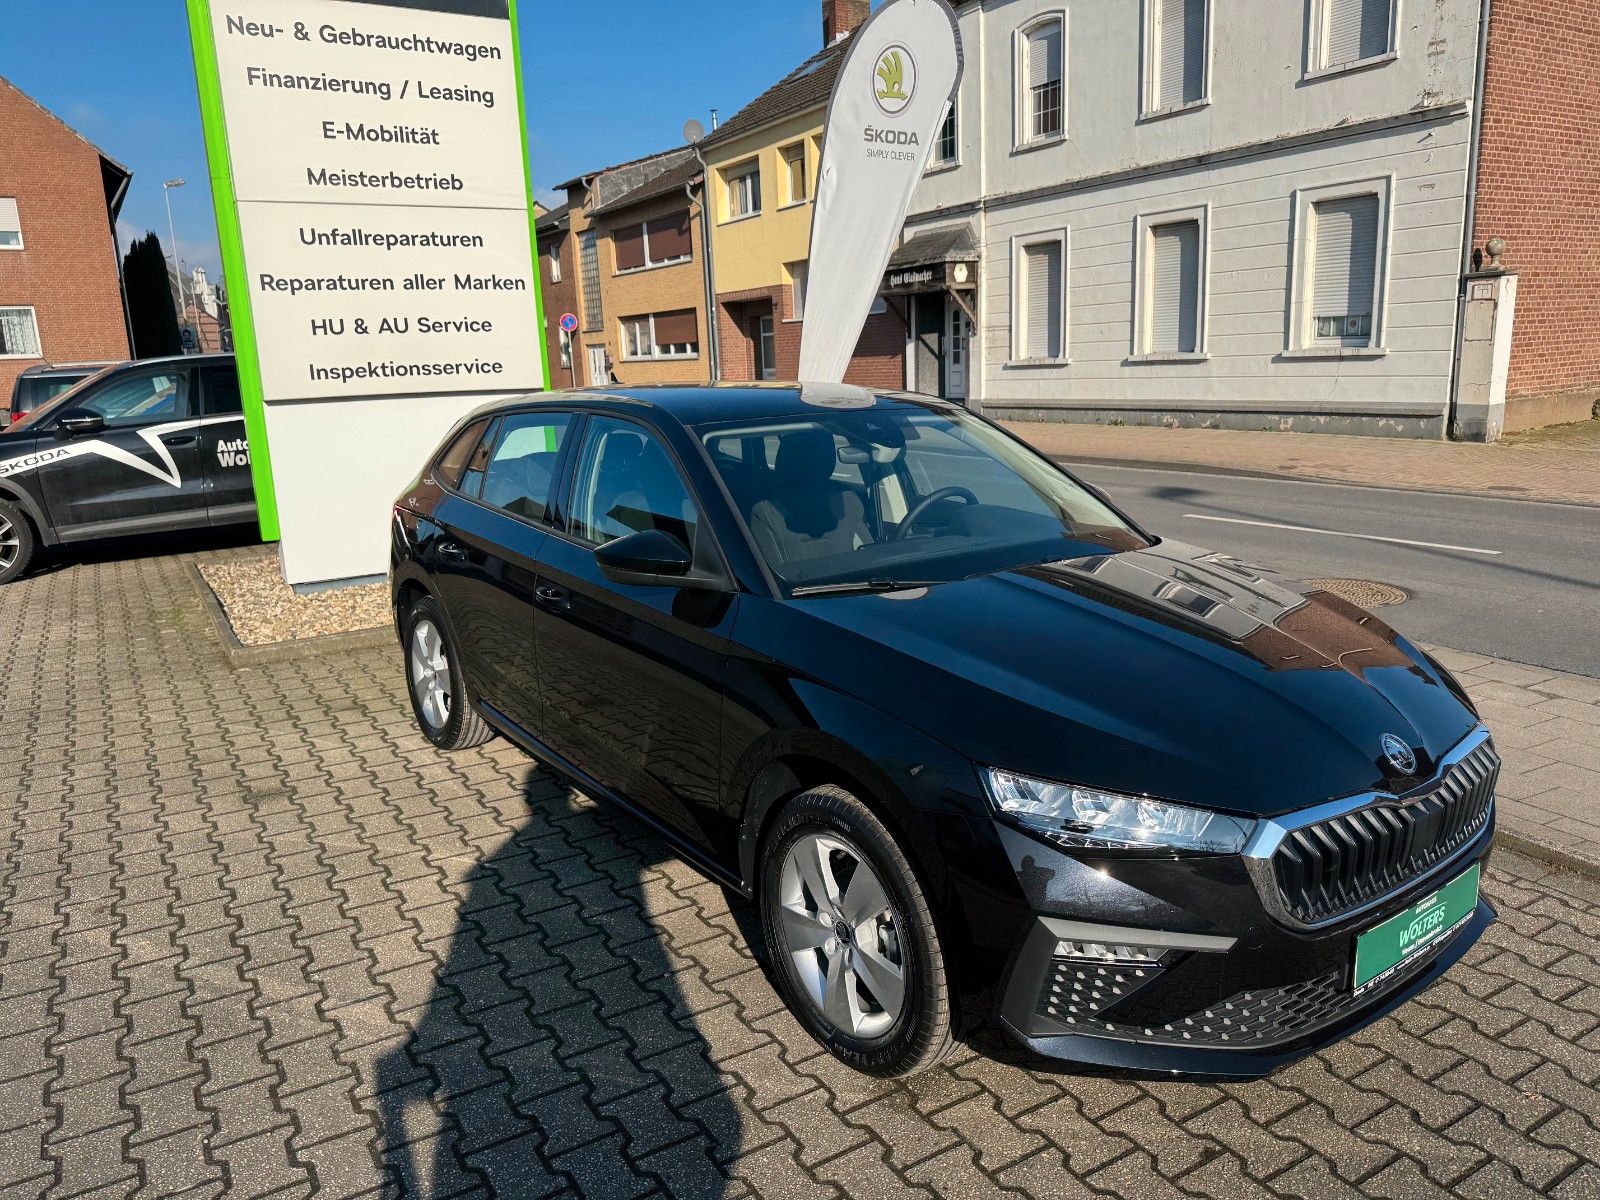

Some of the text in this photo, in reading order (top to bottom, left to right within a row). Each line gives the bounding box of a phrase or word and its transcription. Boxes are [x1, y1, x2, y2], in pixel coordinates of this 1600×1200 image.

[225, 14, 502, 62] Neu- & Gebrauchtwagen
[246, 66, 495, 109] Finanzierung / Leasing
[321, 120, 440, 146] E-Mobilität
[863, 125, 919, 146] ŠKODA
[866, 148, 915, 161] SIMPLY CLEVER
[306, 167, 464, 191] Meisterbetrieb
[299, 227, 484, 251] Unfallreparaturen
[259, 273, 526, 296] Reparaturen aller Marken
[310, 316, 493, 336] HU & AU Service
[309, 358, 503, 384] Inspektionsservice
[1399, 904, 1446, 948] WOLTERS
